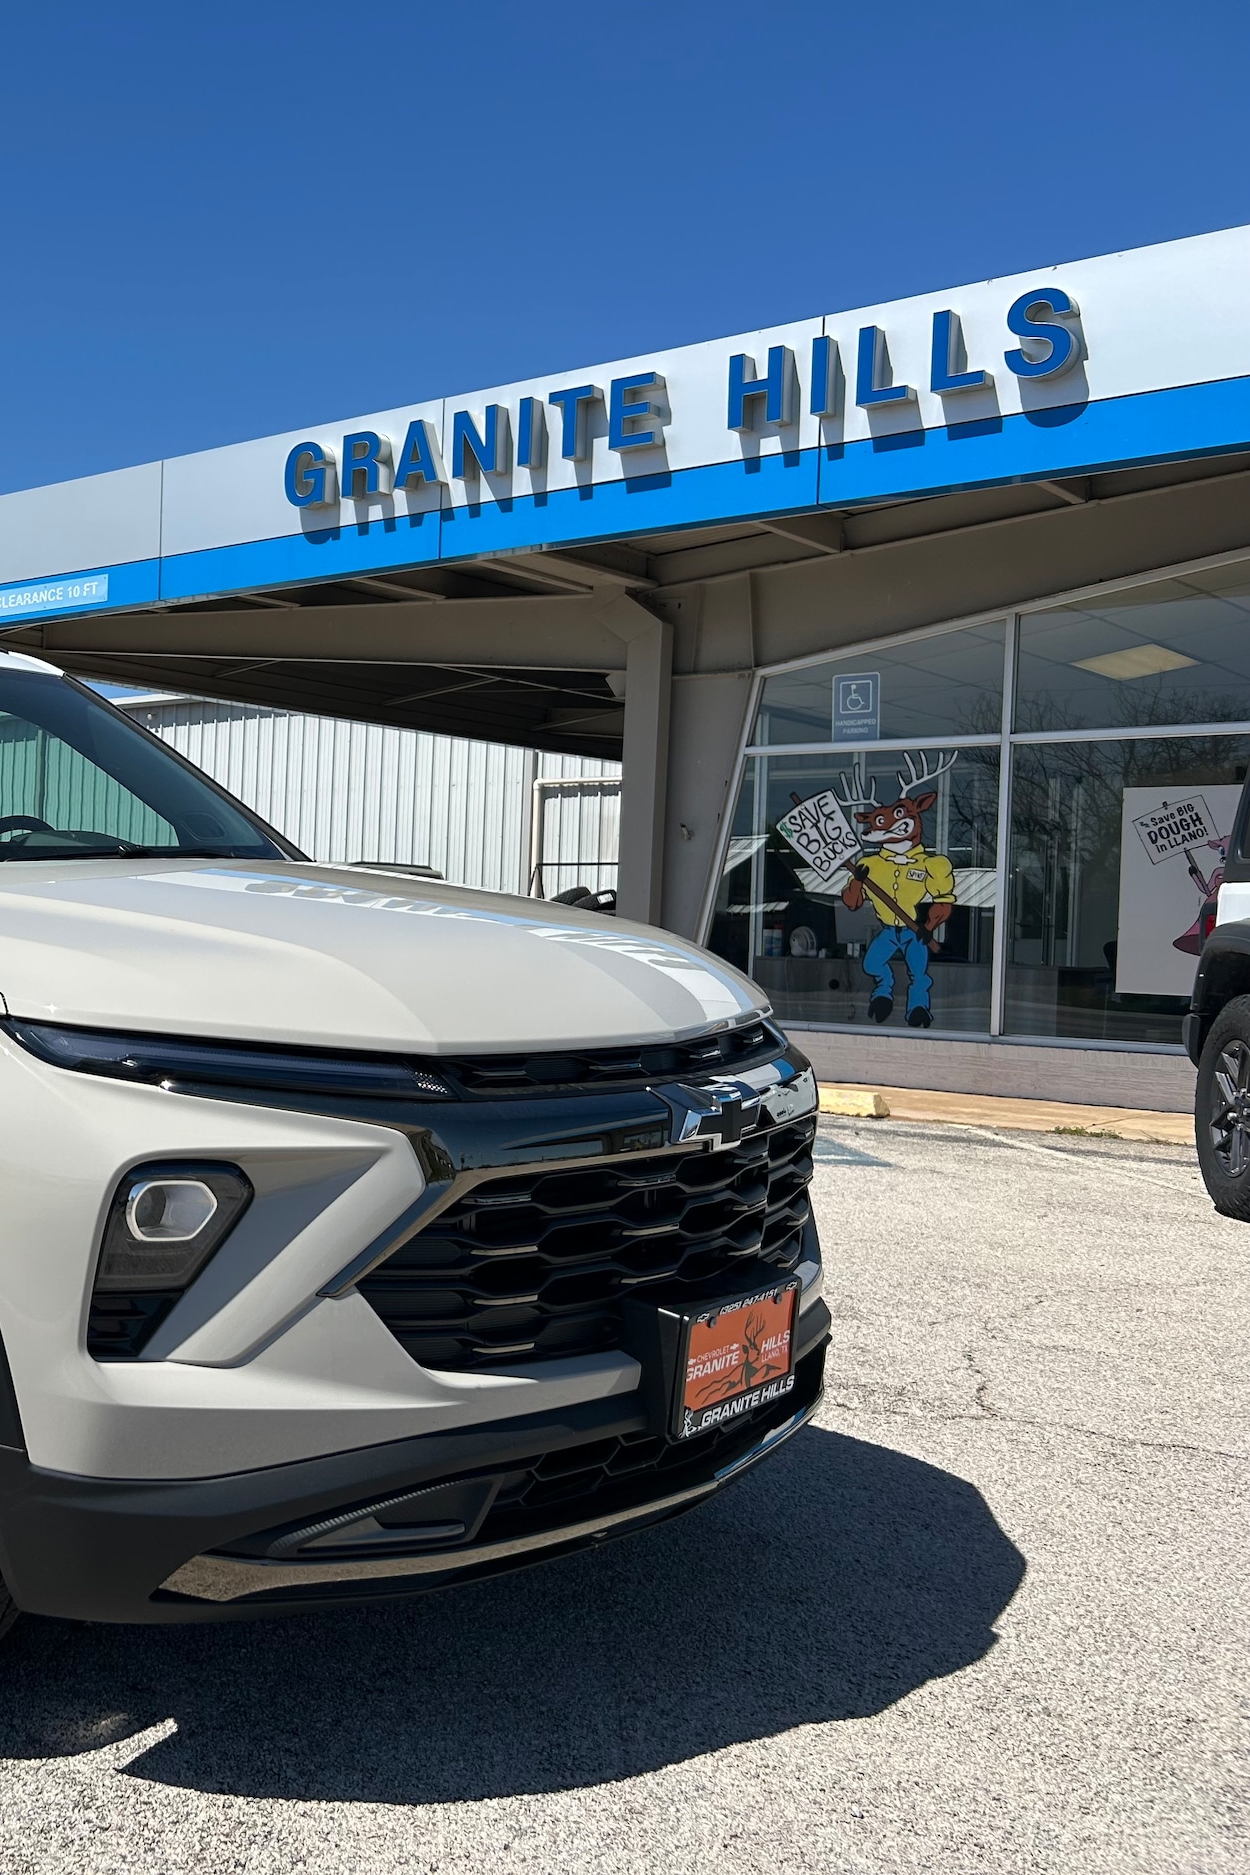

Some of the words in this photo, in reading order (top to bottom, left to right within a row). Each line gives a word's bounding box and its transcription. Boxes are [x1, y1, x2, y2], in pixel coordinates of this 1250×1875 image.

[284, 371, 664, 509] GRANITE
[727, 287, 1080, 433] HILLS
[68, 585, 80, 599] 10
[83, 582, 98, 596] FT
[835, 718, 876, 727] HANDICAPPED
[1150, 812, 1176, 826] Save
[1176, 803, 1195, 817] BIG
[796, 810, 842, 855] BIG
[1147, 812, 1204, 845] DOUGH
[1155, 843, 1168, 853] in
[1169, 826, 1209, 849] LLANO!
[812, 831, 857, 873] BUCKS
[720, 1302, 742, 1316] (325)
[696, 1344, 730, 1363] CHEVROLET
[761, 1329, 791, 1351] HILLS
[686, 1351, 740, 1382] GRANITE
[701, 1393, 761, 1427] GRANITE
[761, 1375, 795, 1400] HILLS
